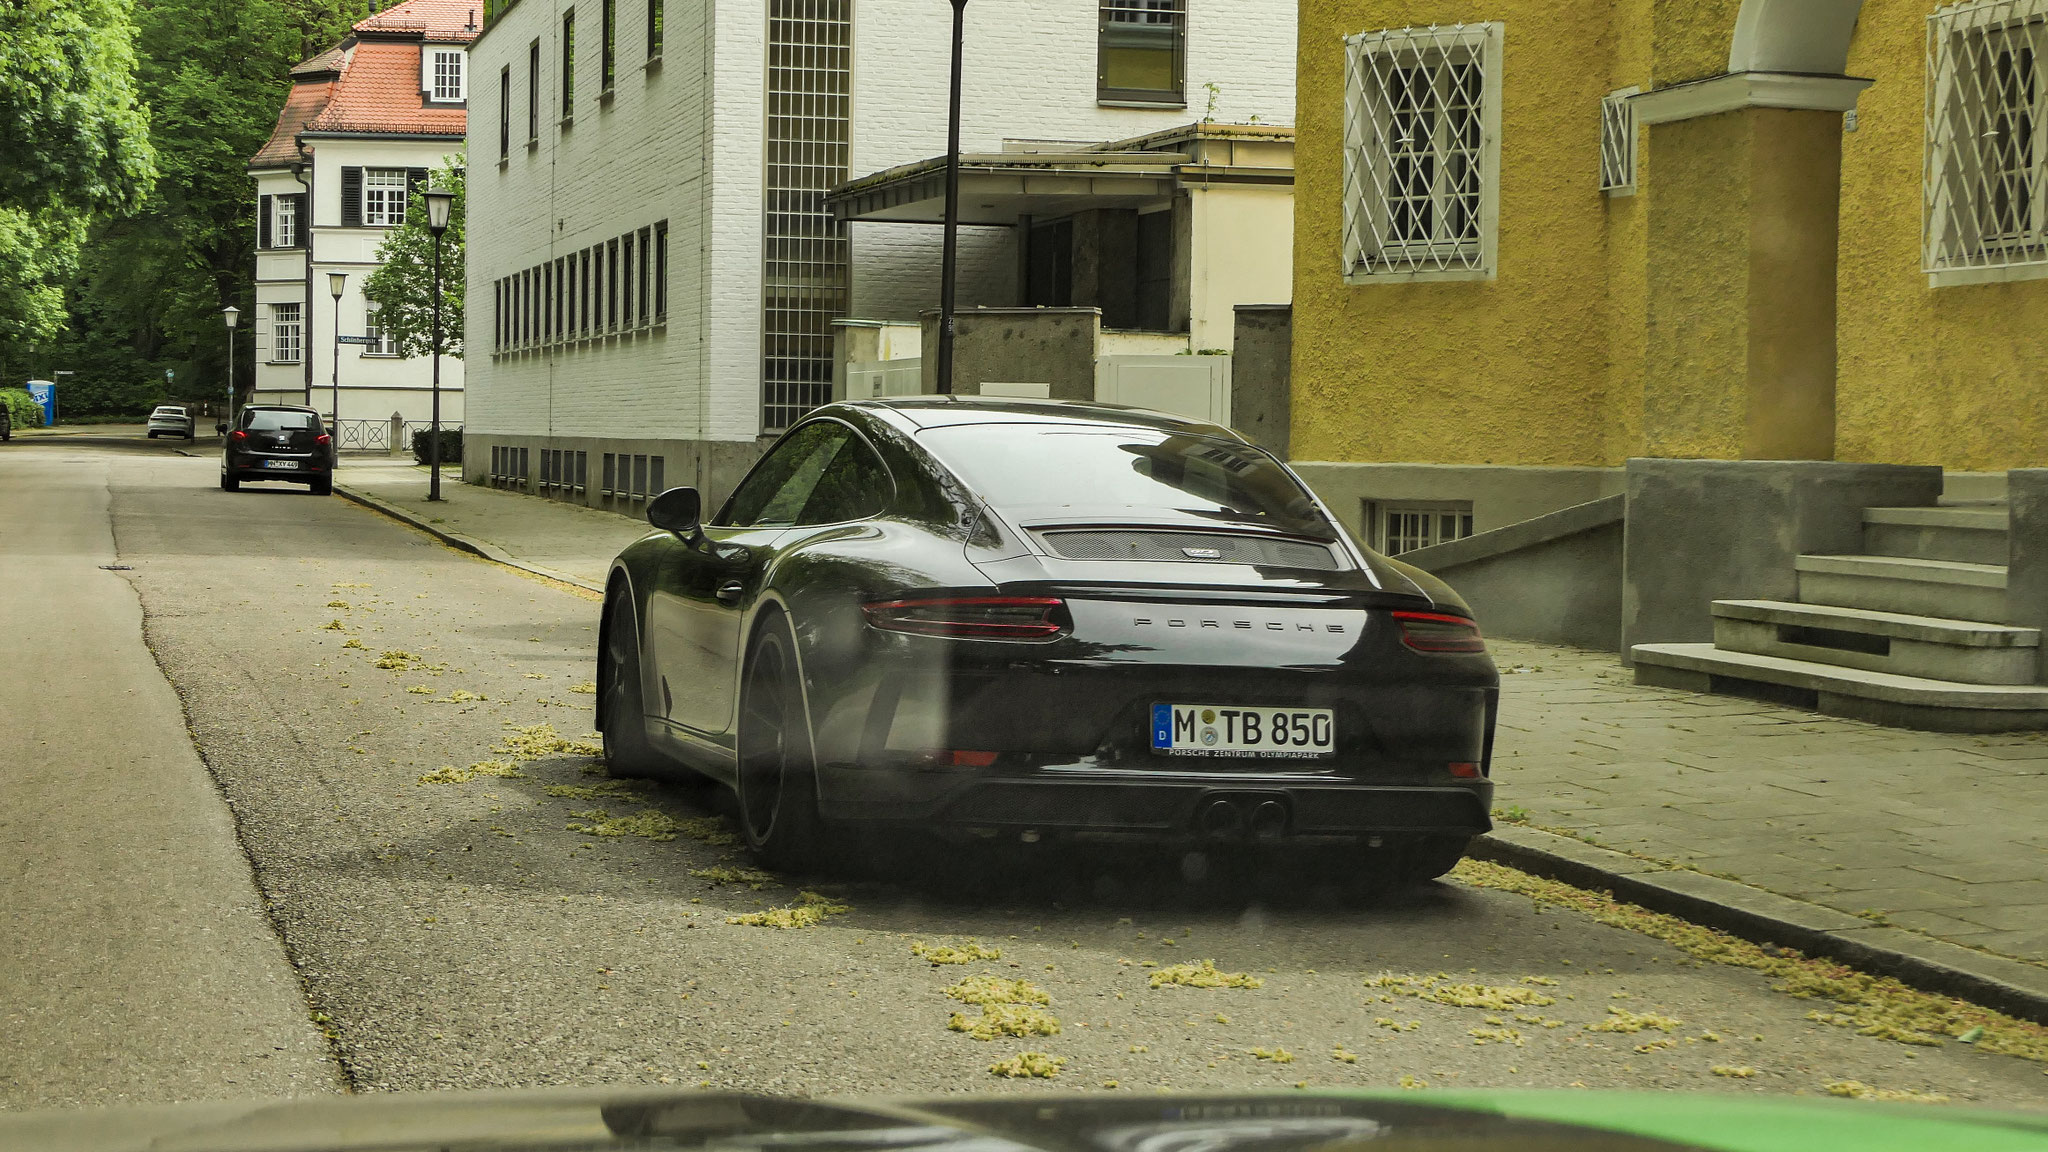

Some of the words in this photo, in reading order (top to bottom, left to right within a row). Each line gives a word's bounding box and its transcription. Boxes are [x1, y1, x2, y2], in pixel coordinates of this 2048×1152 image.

[1134, 618, 1345, 634] PORSCHE
[1174, 709, 1195, 742] M
[1220, 710, 1262, 745] TB
[1271, 712, 1331, 747] 850
[1158, 730, 1167, 741] D
[1169, 749, 1210, 757] PORSCHE
[1213, 750, 1256, 758] ZENTRUM
[1260, 751, 1319, 759] OLYMPIAPARK
